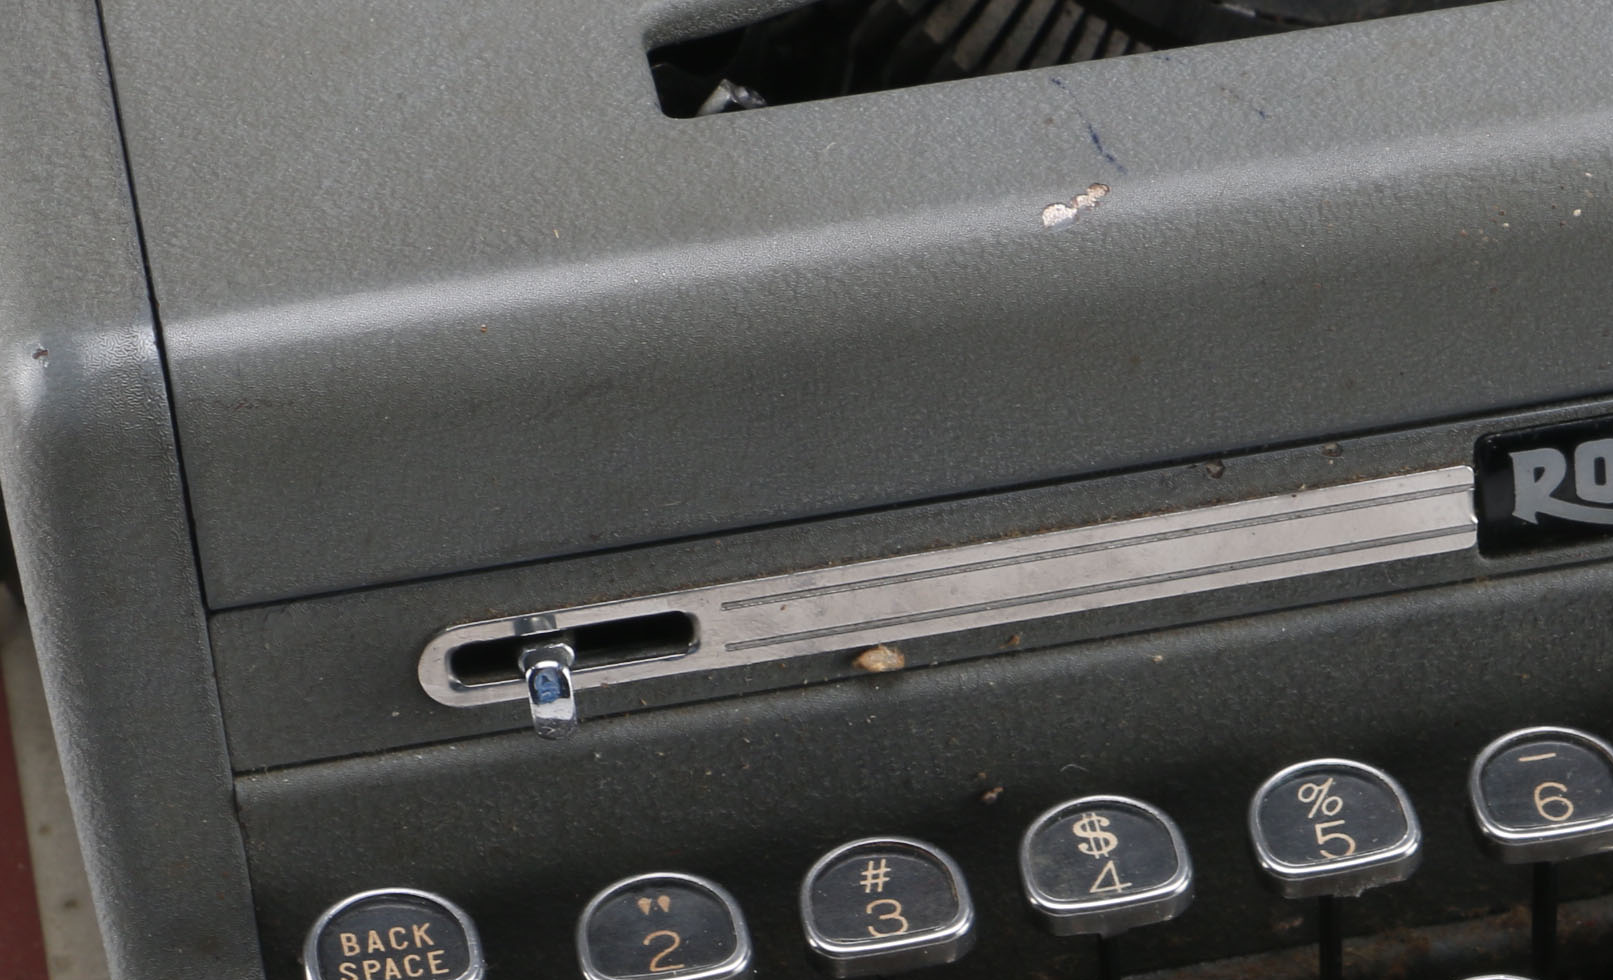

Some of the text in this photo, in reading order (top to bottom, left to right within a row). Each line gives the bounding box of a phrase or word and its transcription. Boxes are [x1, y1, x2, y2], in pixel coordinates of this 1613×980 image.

[1296, 777, 1344, 819] %
[1533, 781, 1575, 822] 6
[1072, 812, 1118, 859] $
[1314, 819, 1357, 860] 5
[859, 858, 890, 893] #
[1088, 859, 1132, 897] 4
[865, 898, 909, 939] 3
[339, 922, 436, 958] BACK
[642, 929, 685, 974] 2
